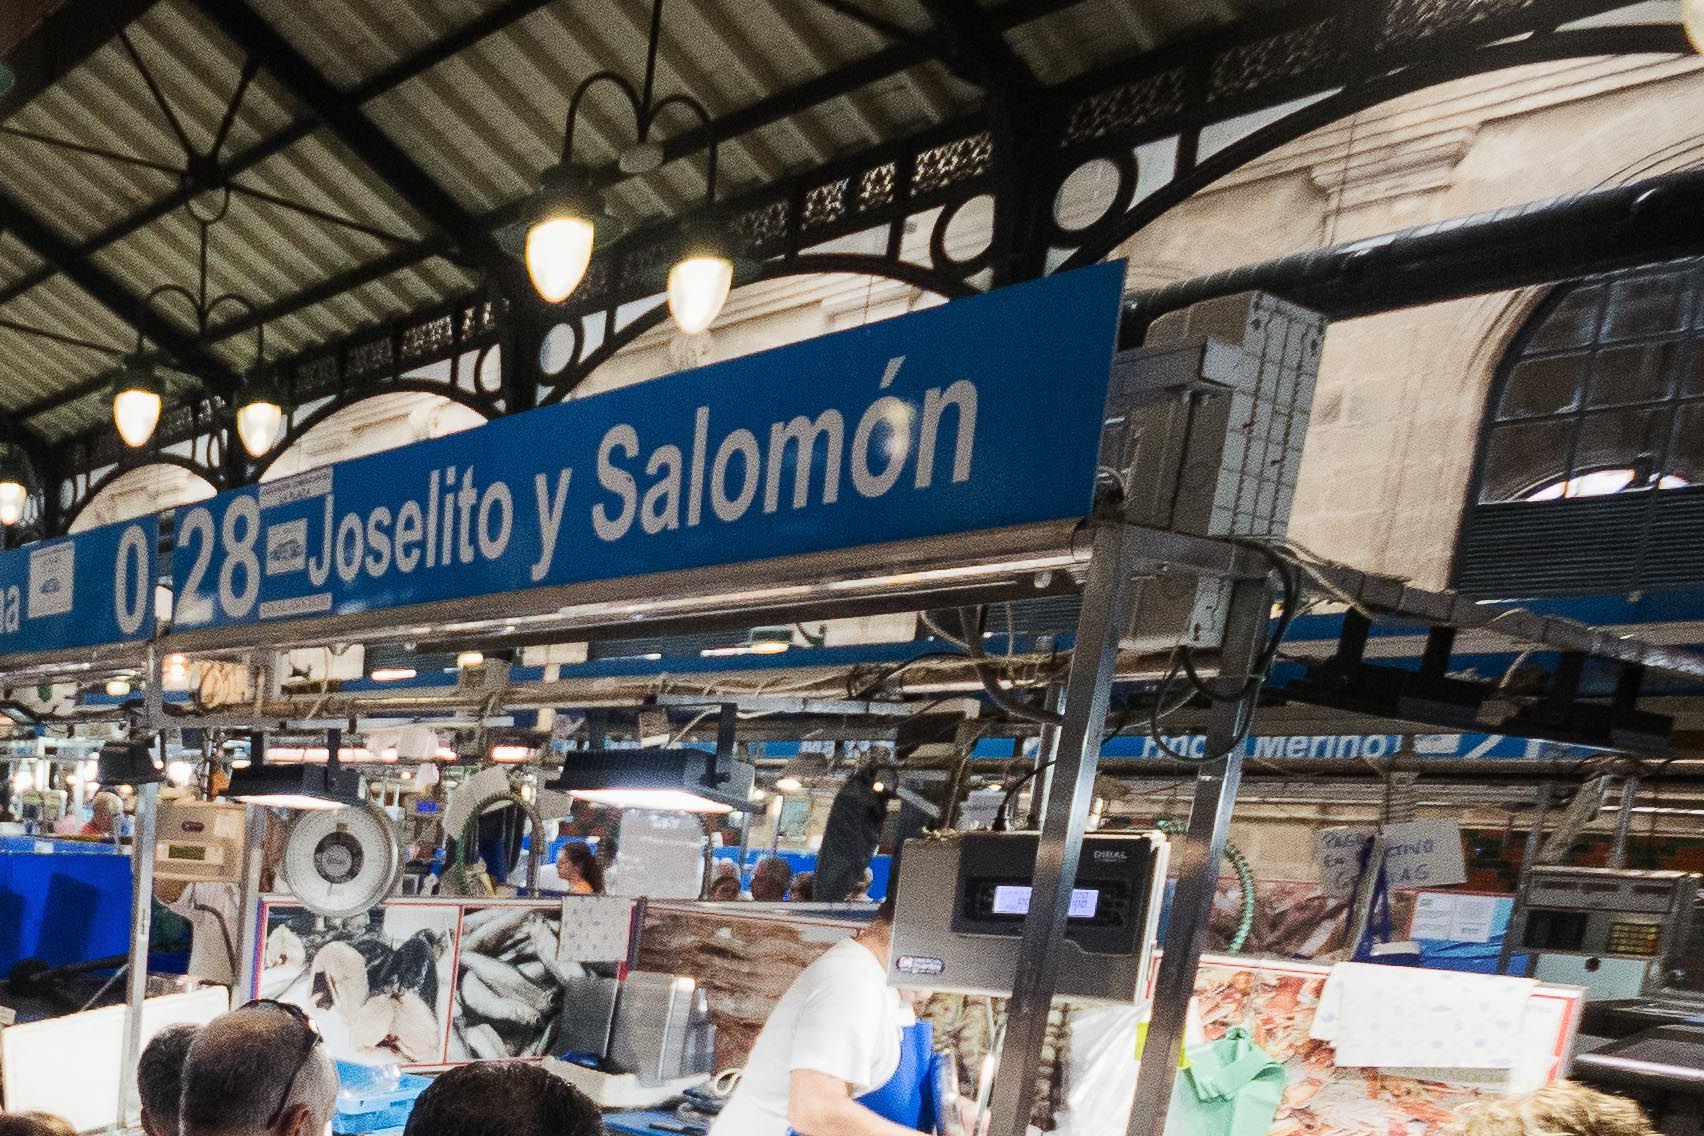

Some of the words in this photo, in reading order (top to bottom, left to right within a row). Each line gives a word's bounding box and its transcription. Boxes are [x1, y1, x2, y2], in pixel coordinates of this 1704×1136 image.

[173, 494, 261, 625] 28
[308, 465, 514, 586] Joselito
[531, 467, 573, 582] y
[592, 355, 978, 542] Salomón
